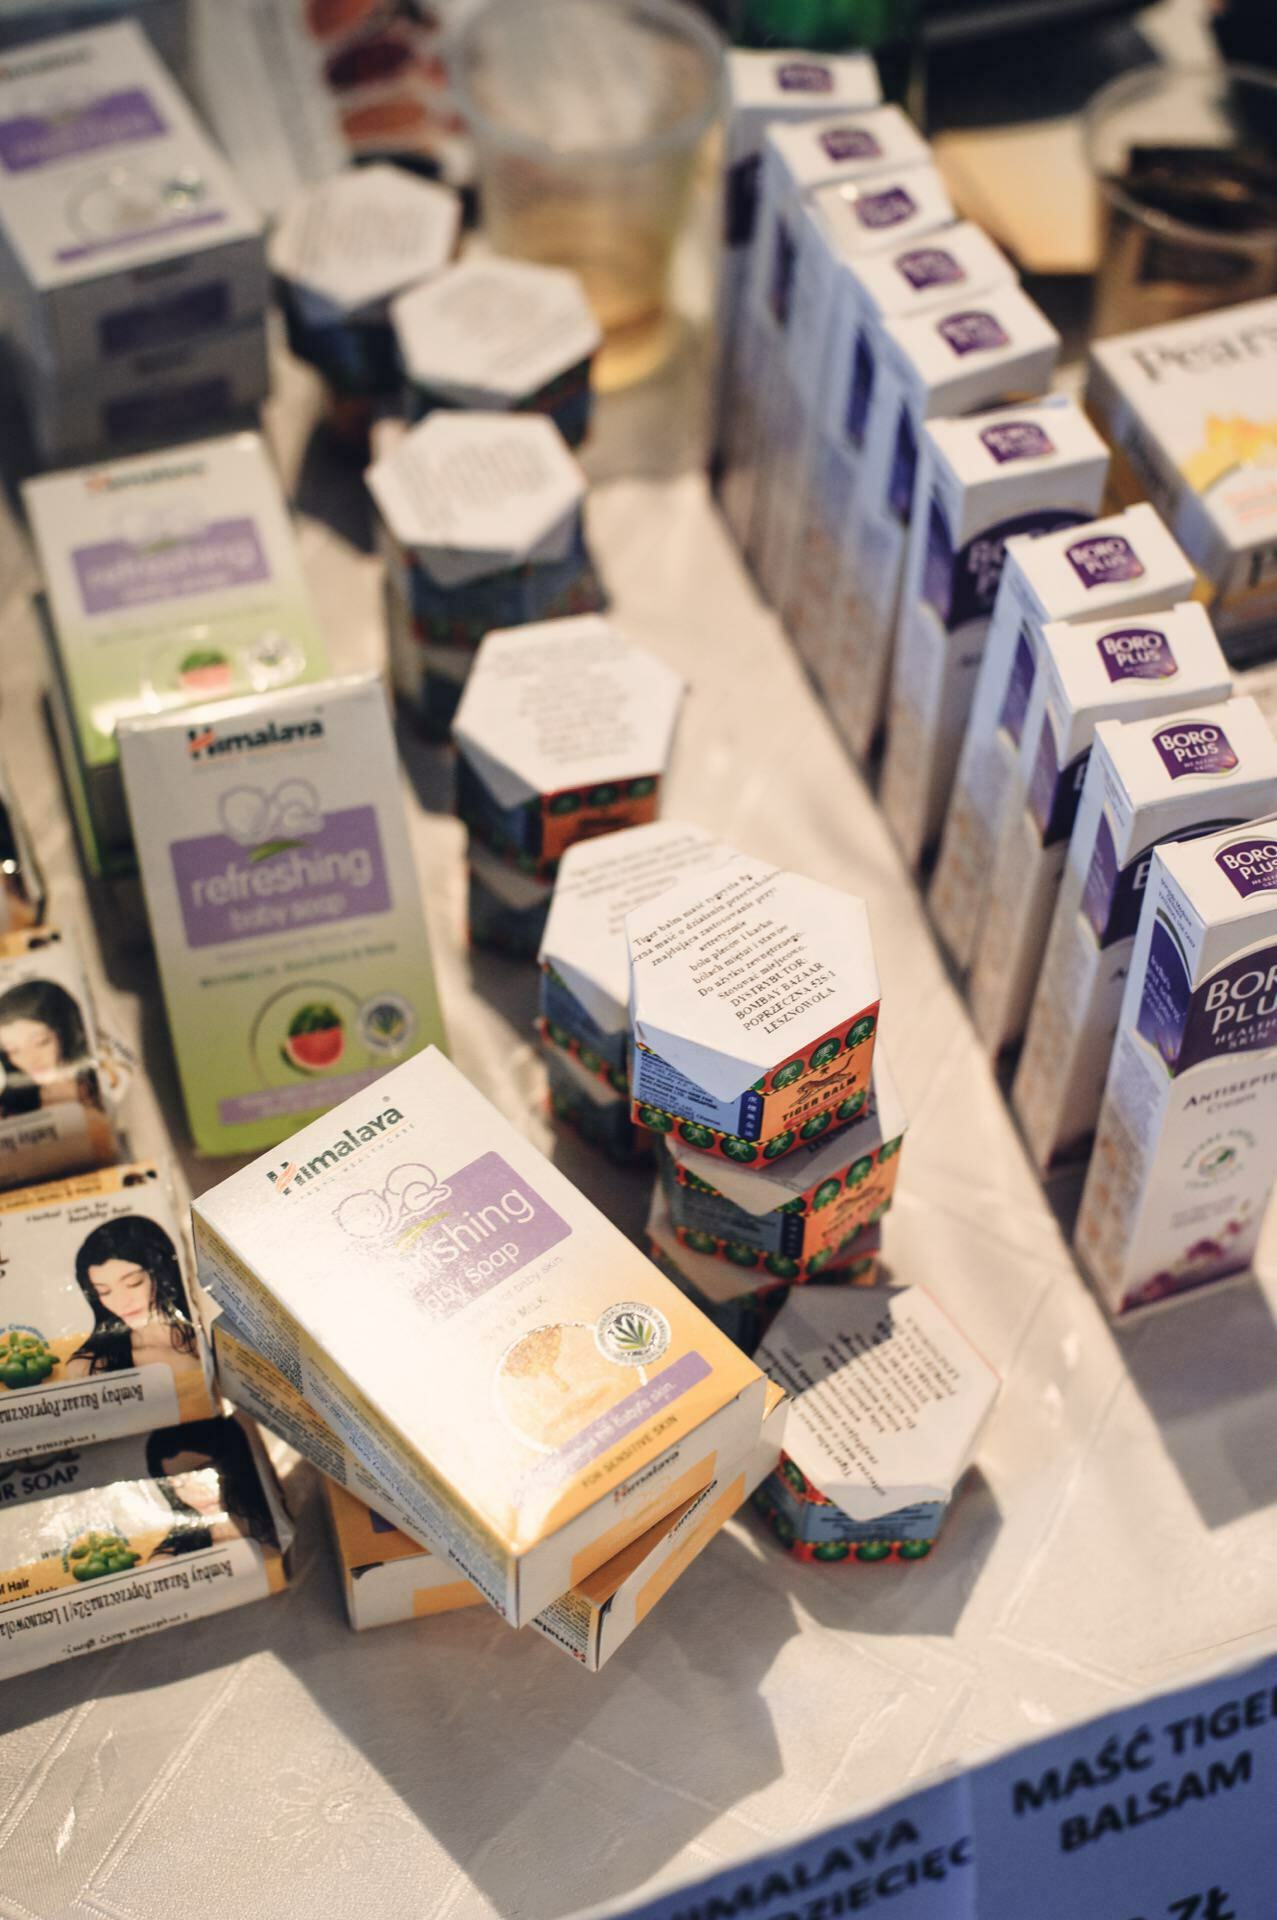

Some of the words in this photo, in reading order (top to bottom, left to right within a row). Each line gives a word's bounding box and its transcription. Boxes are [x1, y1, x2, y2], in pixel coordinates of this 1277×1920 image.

[1103, 633, 1163, 655] BORO
[1115, 648, 1161, 668] PLUS
[187, 717, 325, 760] Himalaya
[1159, 728, 1220, 752] BORO
[1173, 743, 1220, 763] PLUS
[192, 847, 374, 908] refreshing
[1222, 845, 1277, 869] BORO
[229, 903, 288, 933] baby
[697, 986, 715, 998] Do
[735, 986, 782, 1020] BOMBAY
[783, 961, 826, 992] BAZAAR
[743, 986, 812, 1031] POPRZECZNA
[763, 987, 836, 1035] LESZNOWOLA
[782, 1096, 819, 1122] TIGER
[823, 1074, 857, 1100] BALM
[265, 1106, 405, 1196] Himalaya
[464, 1240, 521, 1285] soap
[602, 1432, 653, 1474] SENSITIVE
[653, 1414, 679, 1436] SKIN
[23, 1464, 80, 1496] SOAP
[7, 1577, 30, 1594] Hair
[1011, 1724, 1154, 1818] MAŚĆ
[1060, 1751, 1253, 1855] BALSAM
